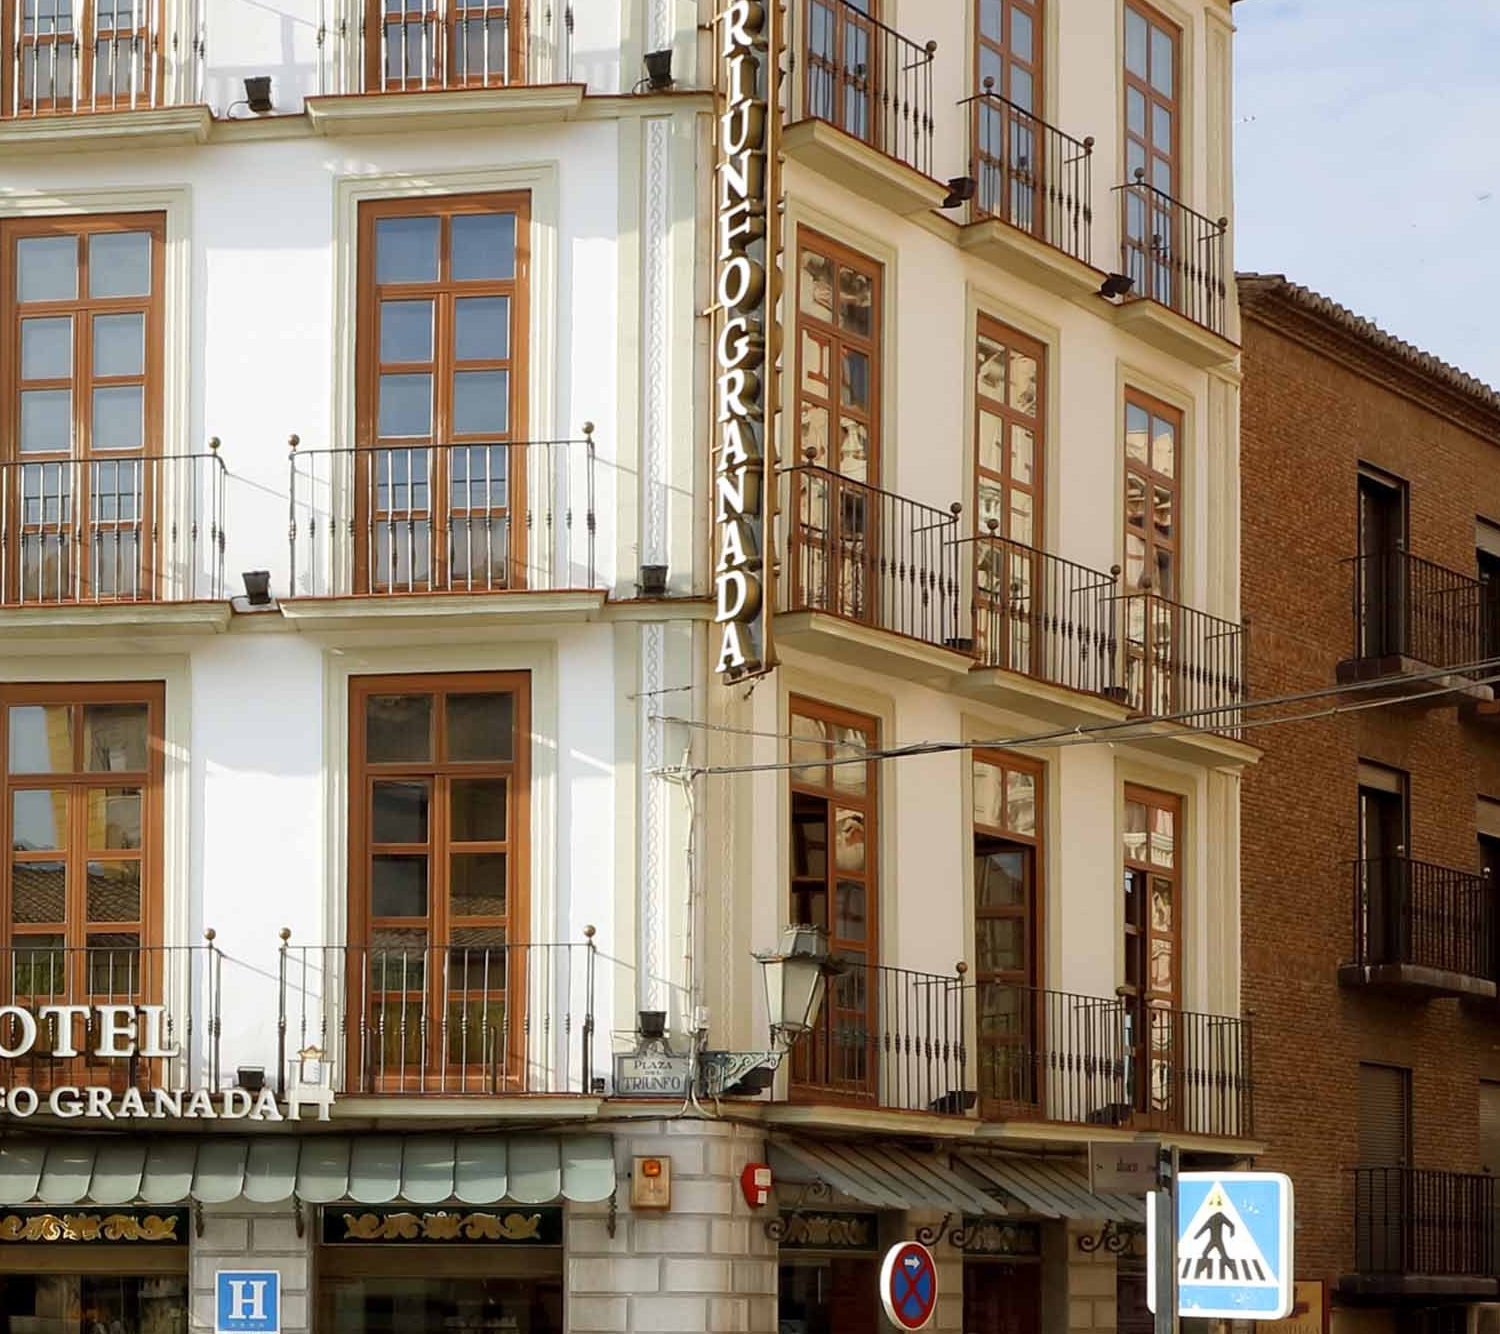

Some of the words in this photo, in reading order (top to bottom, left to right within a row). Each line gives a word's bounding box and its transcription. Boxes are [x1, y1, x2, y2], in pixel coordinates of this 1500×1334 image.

[714, 315, 753, 674] GRANADA
[633, 1059, 673, 1069] PLAZA
[623, 1076, 681, 1090] TRIUNFO
[50, 1085, 284, 1121] GRANADA
[228, 1280, 268, 1320] H
